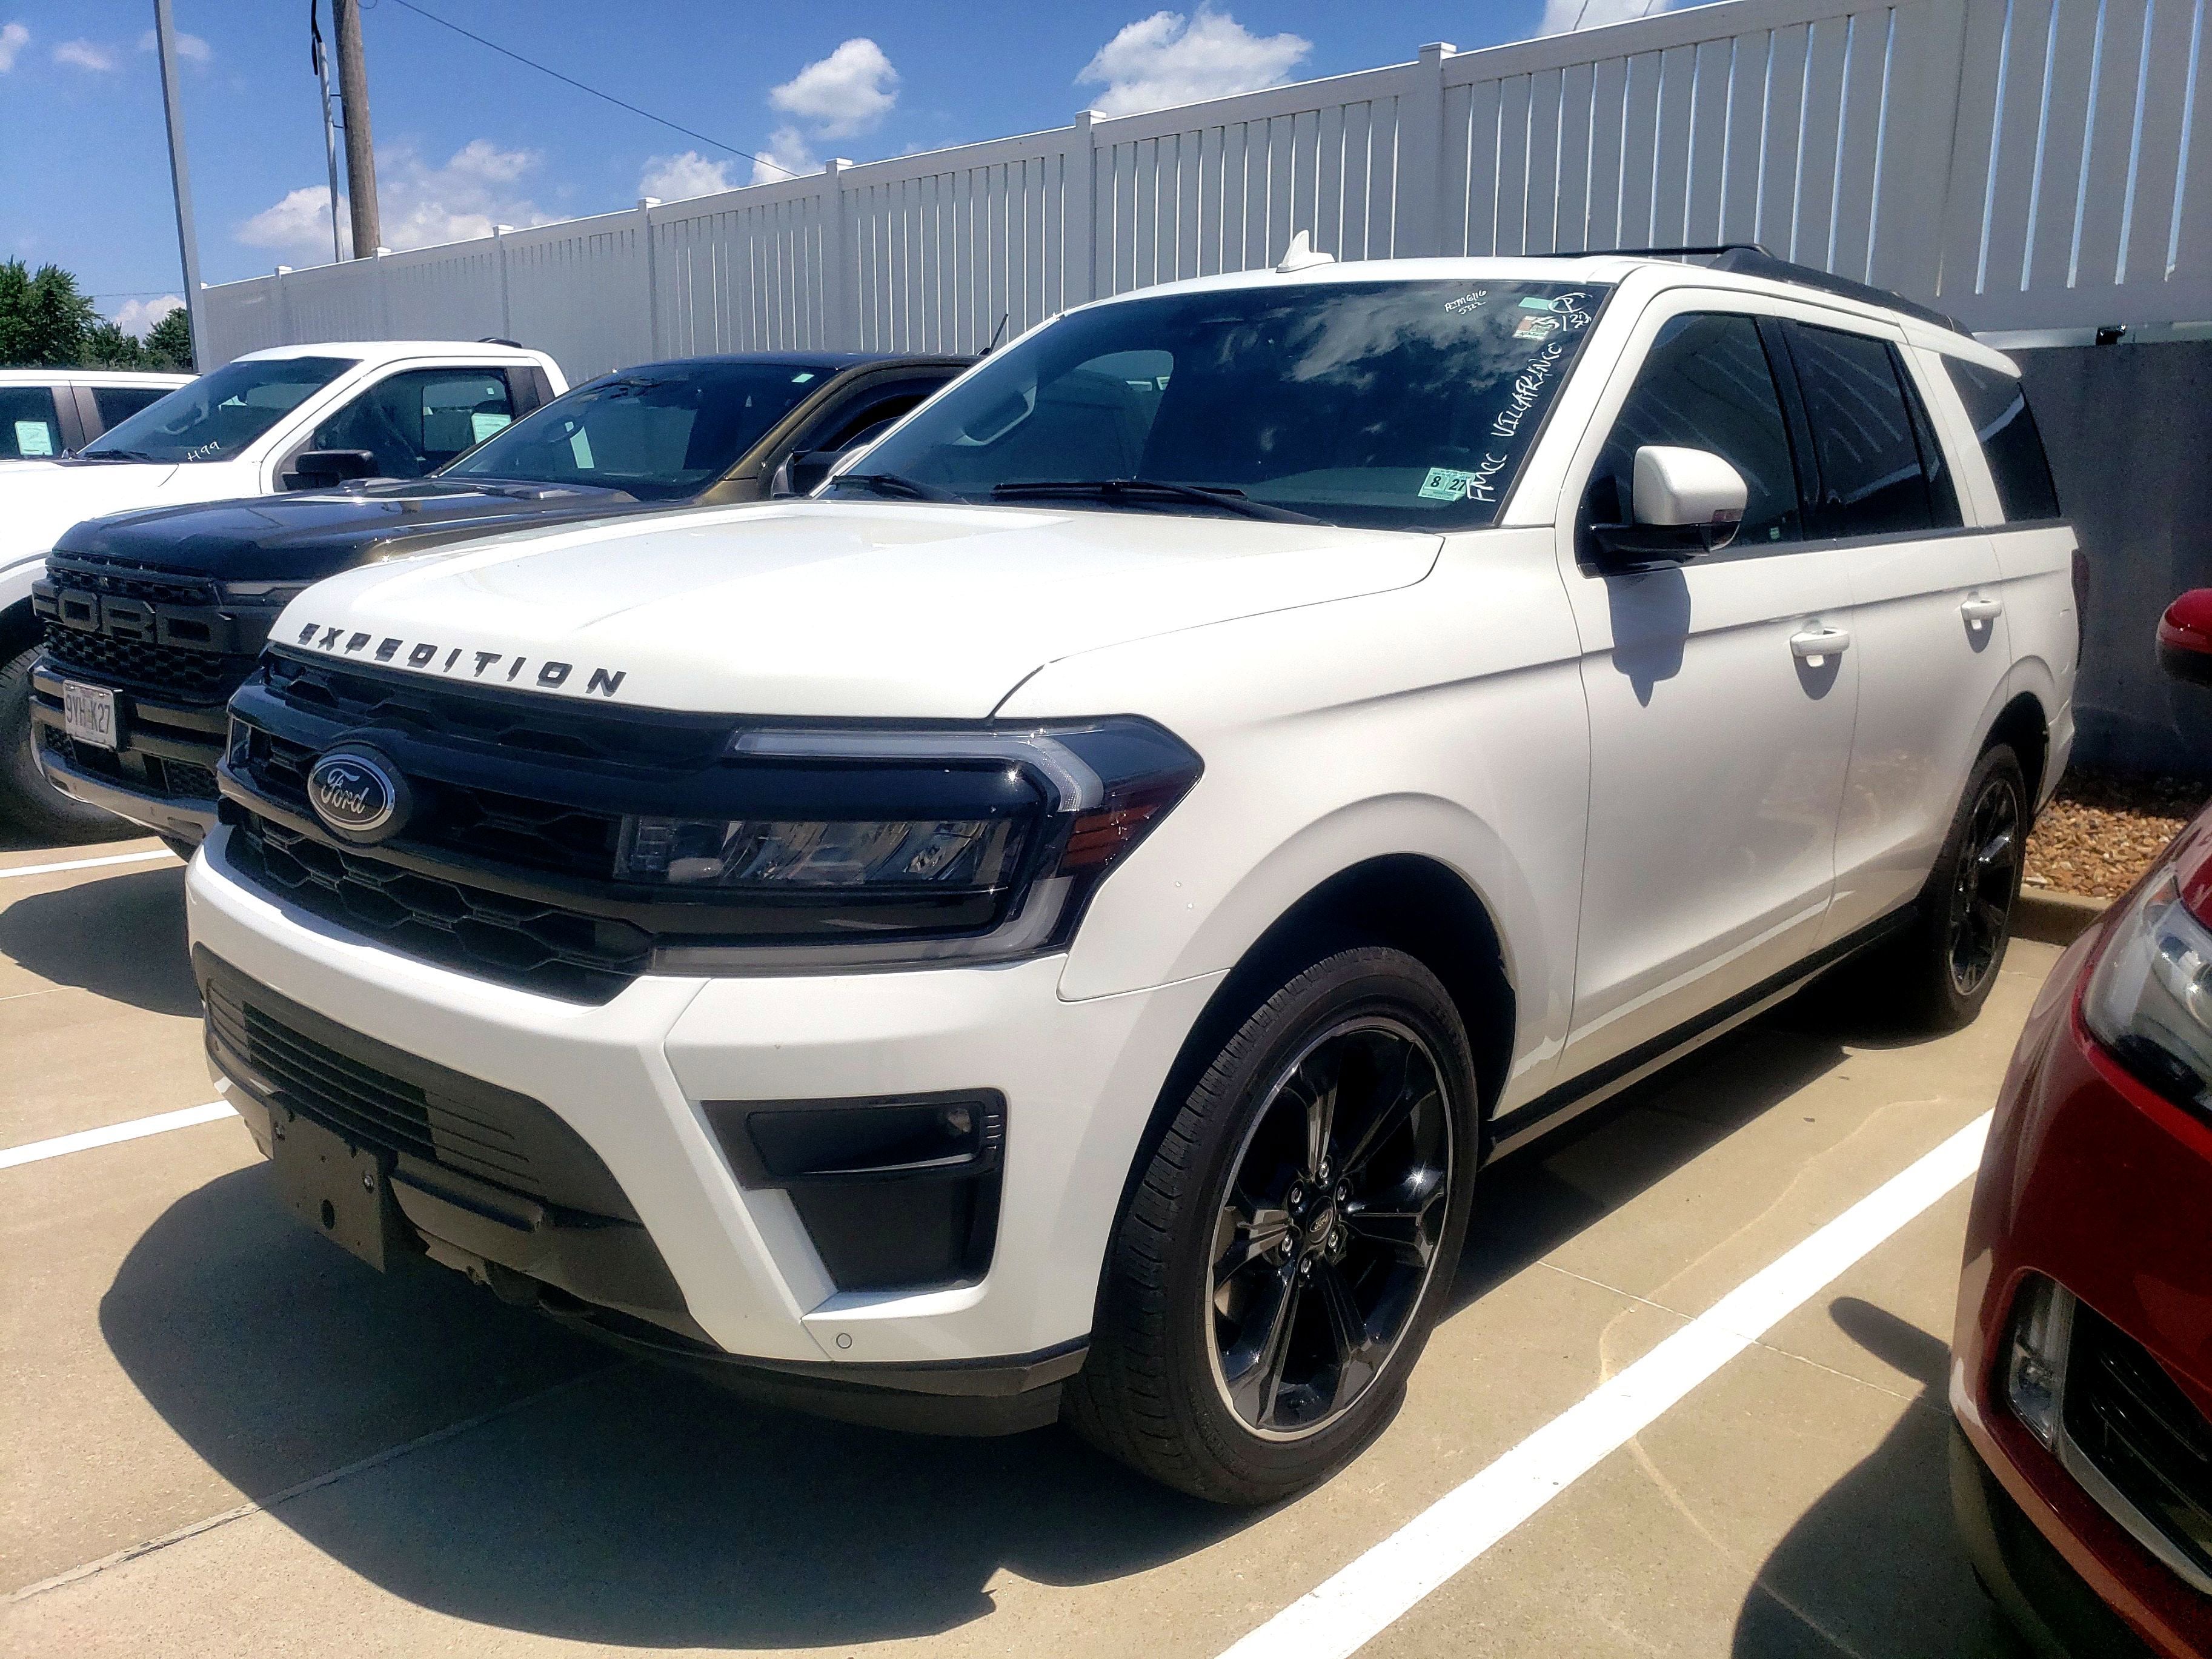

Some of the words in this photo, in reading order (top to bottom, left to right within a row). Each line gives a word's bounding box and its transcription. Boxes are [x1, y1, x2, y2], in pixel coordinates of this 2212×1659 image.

[1430, 476, 1441, 487] 8
[1449, 479, 1467, 491] 27
[1466, 453, 1507, 502] FMCC
[298, 622, 626, 697] EXPEDITION
[90, 700, 111, 734] K27
[319, 768, 370, 815] Ford
